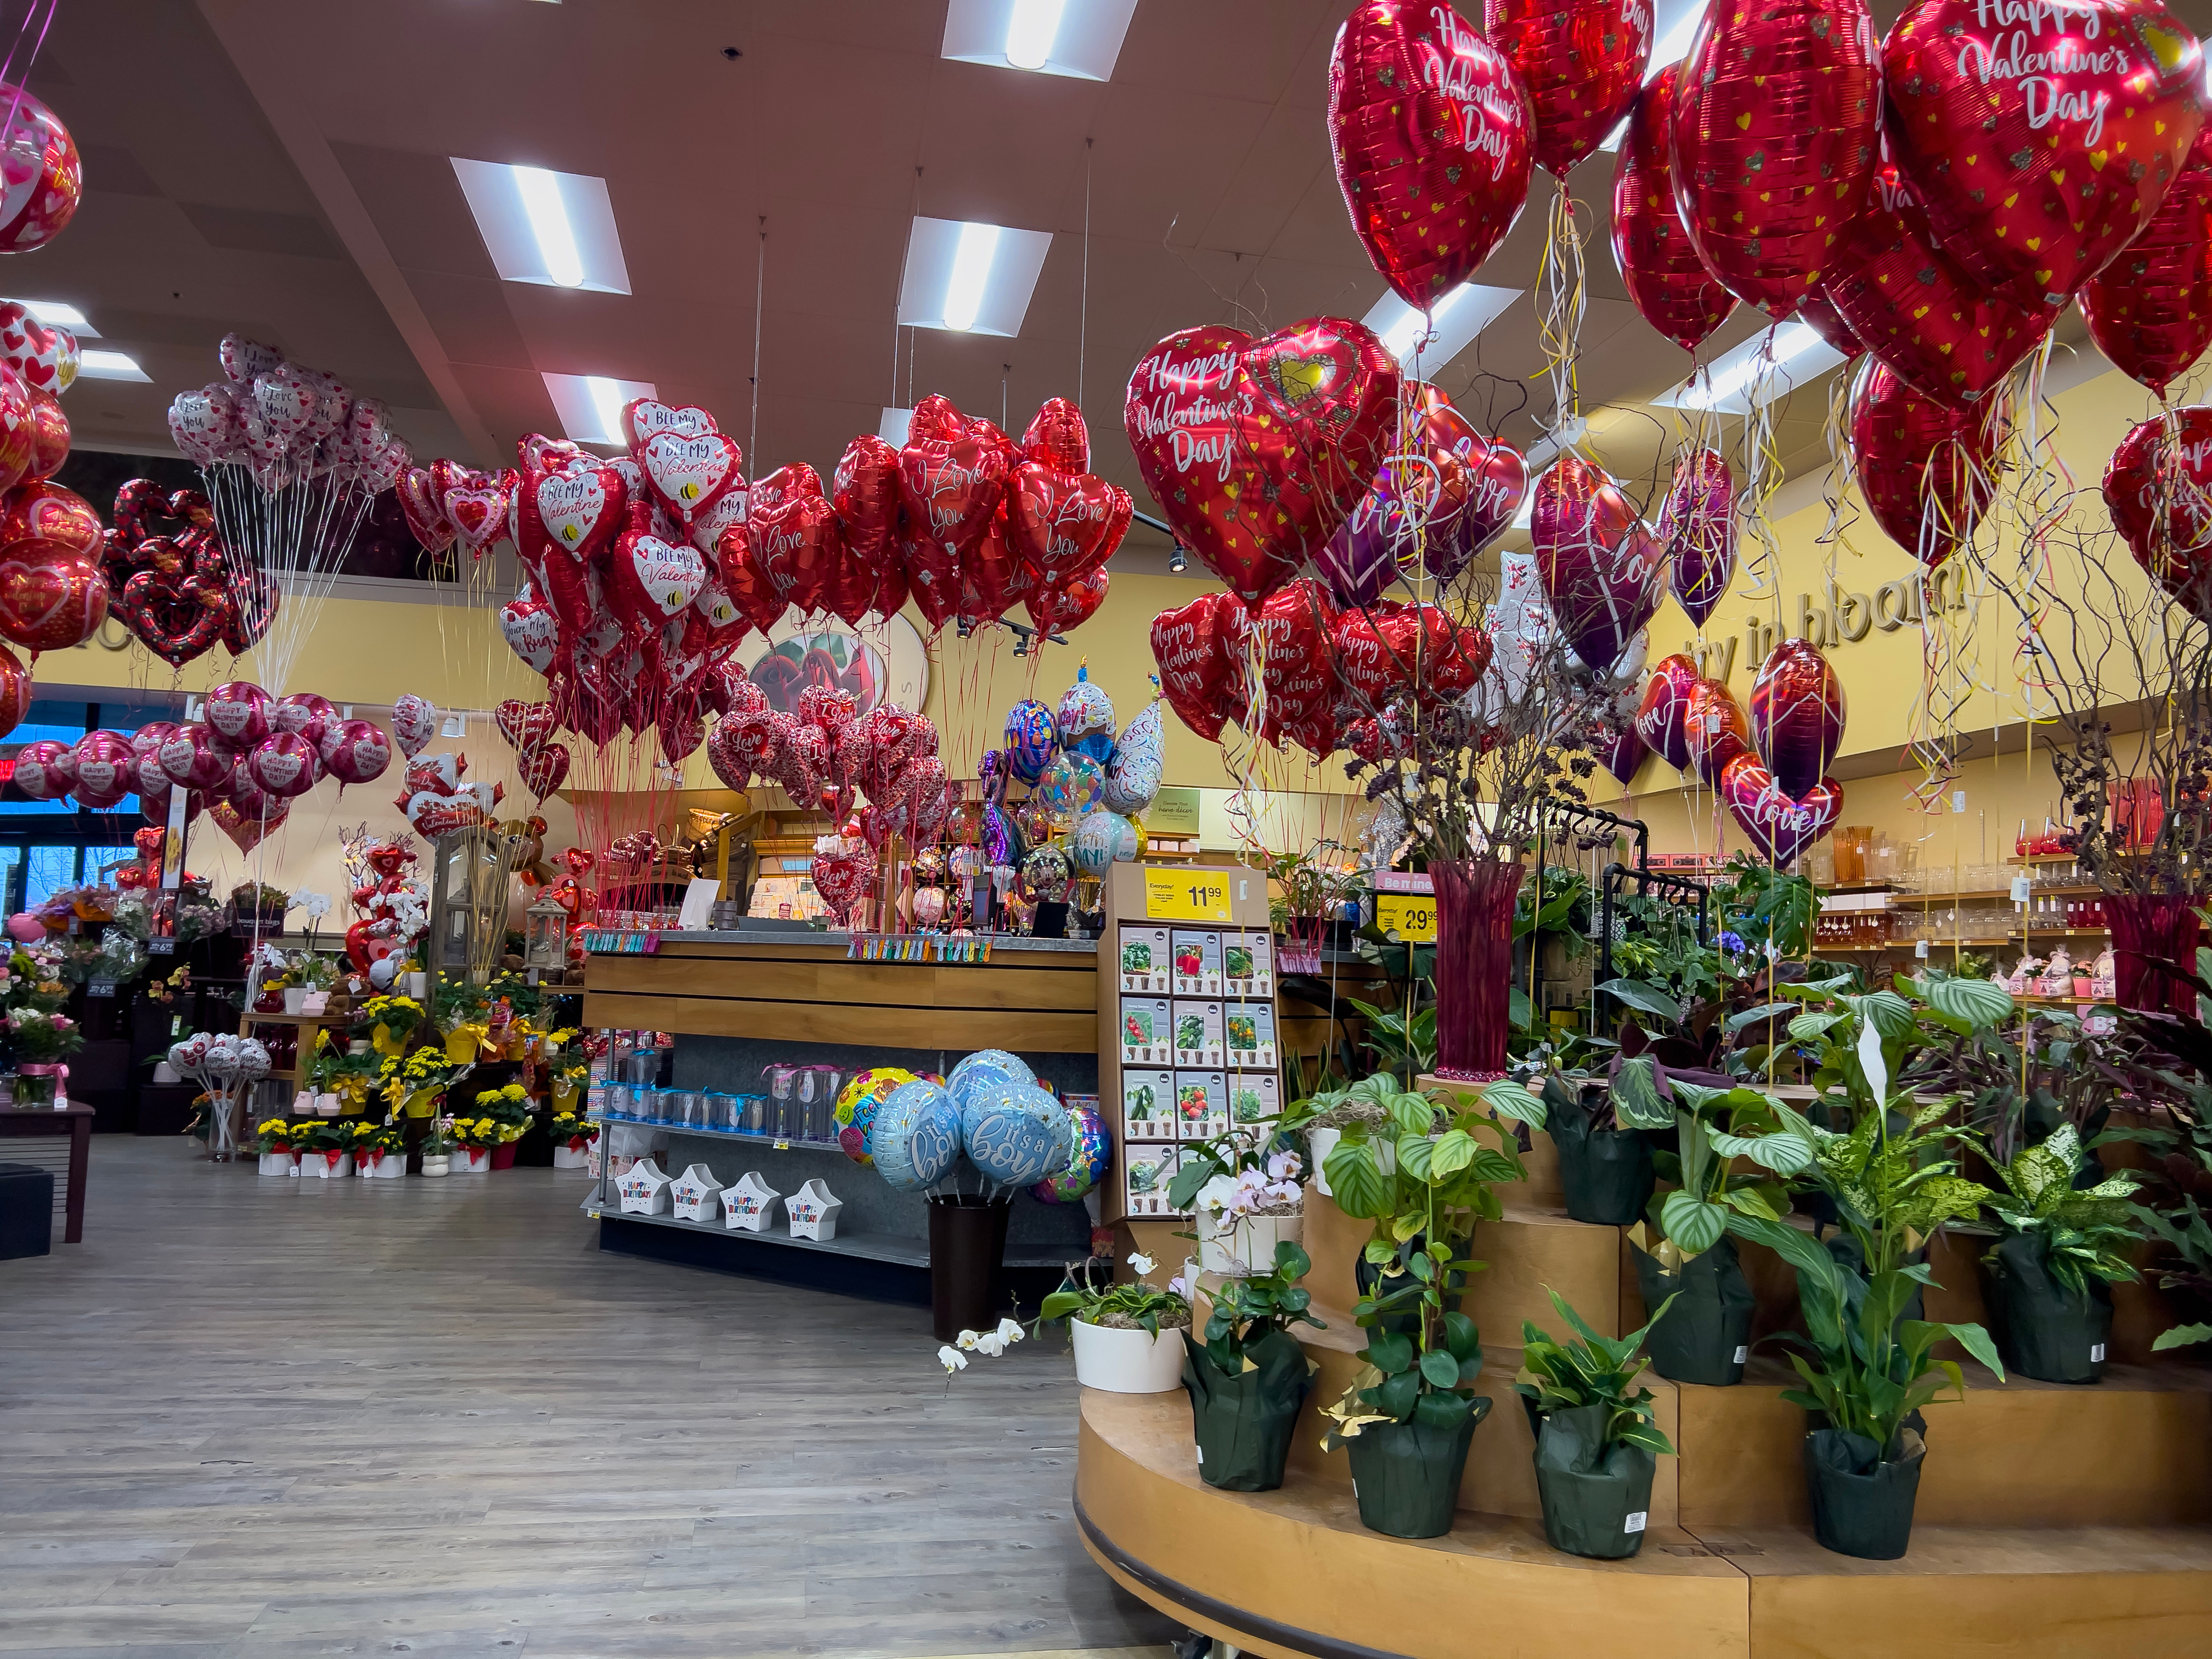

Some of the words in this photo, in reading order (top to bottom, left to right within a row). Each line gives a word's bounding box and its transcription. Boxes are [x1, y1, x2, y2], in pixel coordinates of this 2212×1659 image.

[1430, 7, 1510, 87] Happy
[1957, 30, 2130, 84] Valentine's
[1424, 57, 1522, 127] Valentine's
[2018, 76, 2111, 147] Day
[1461, 105, 1511, 182] Day
[1145, 349, 1239, 394] Happy
[183, 415, 205, 428] You
[266, 404, 291, 419] You
[656, 411, 675, 426] BEE
[1137, 391, 1255, 440] Valentine's
[665, 441, 686, 458] BEE
[1167, 429, 1236, 482] Day
[652, 456, 727, 483] Valentine
[932, 458, 985, 499] Love
[548, 484, 564, 500] BEE
[565, 482, 584, 499] MY
[541, 498, 602, 521] Valentine
[925, 496, 966, 538] You
[1054, 490, 1104, 526] Love
[765, 524, 806, 566] Love
[1042, 522, 1079, 564] You
[656, 549, 675, 562] BEE
[641, 563, 706, 586] Valentine
[765, 564, 799, 611] You
[529, 617, 547, 636] My
[1746, 616, 1786, 672] in
[1797, 562, 1967, 649] bloom
[522, 633, 554, 653] Bug
[1153, 622, 1195, 646] Happy
[1339, 624, 1382, 664] Happy
[1170, 668, 1204, 695] Day
[1269, 694, 1302, 718] Day
[732, 732, 763, 752] Love
[1385, 877, 1400, 888] Be
[1005, 1122, 1032, 1150] it's
[1034, 1138, 1045, 1152] a
[973, 1114, 1054, 1185] boy!
[623, 1189, 651, 1198] BIRTHDAY!
[628, 1181, 647, 1189] HAPPY
[680, 1187, 697, 1196] HAPPY
[675, 1194, 699, 1206] BIRTHDAY!
[729, 1204, 759, 1215] BIRTHDAY!
[734, 1196, 755, 1206] HAPPY
[795, 1204, 814, 1214] HAPPY
[792, 1212, 817, 1223] BIRTHDAY!
